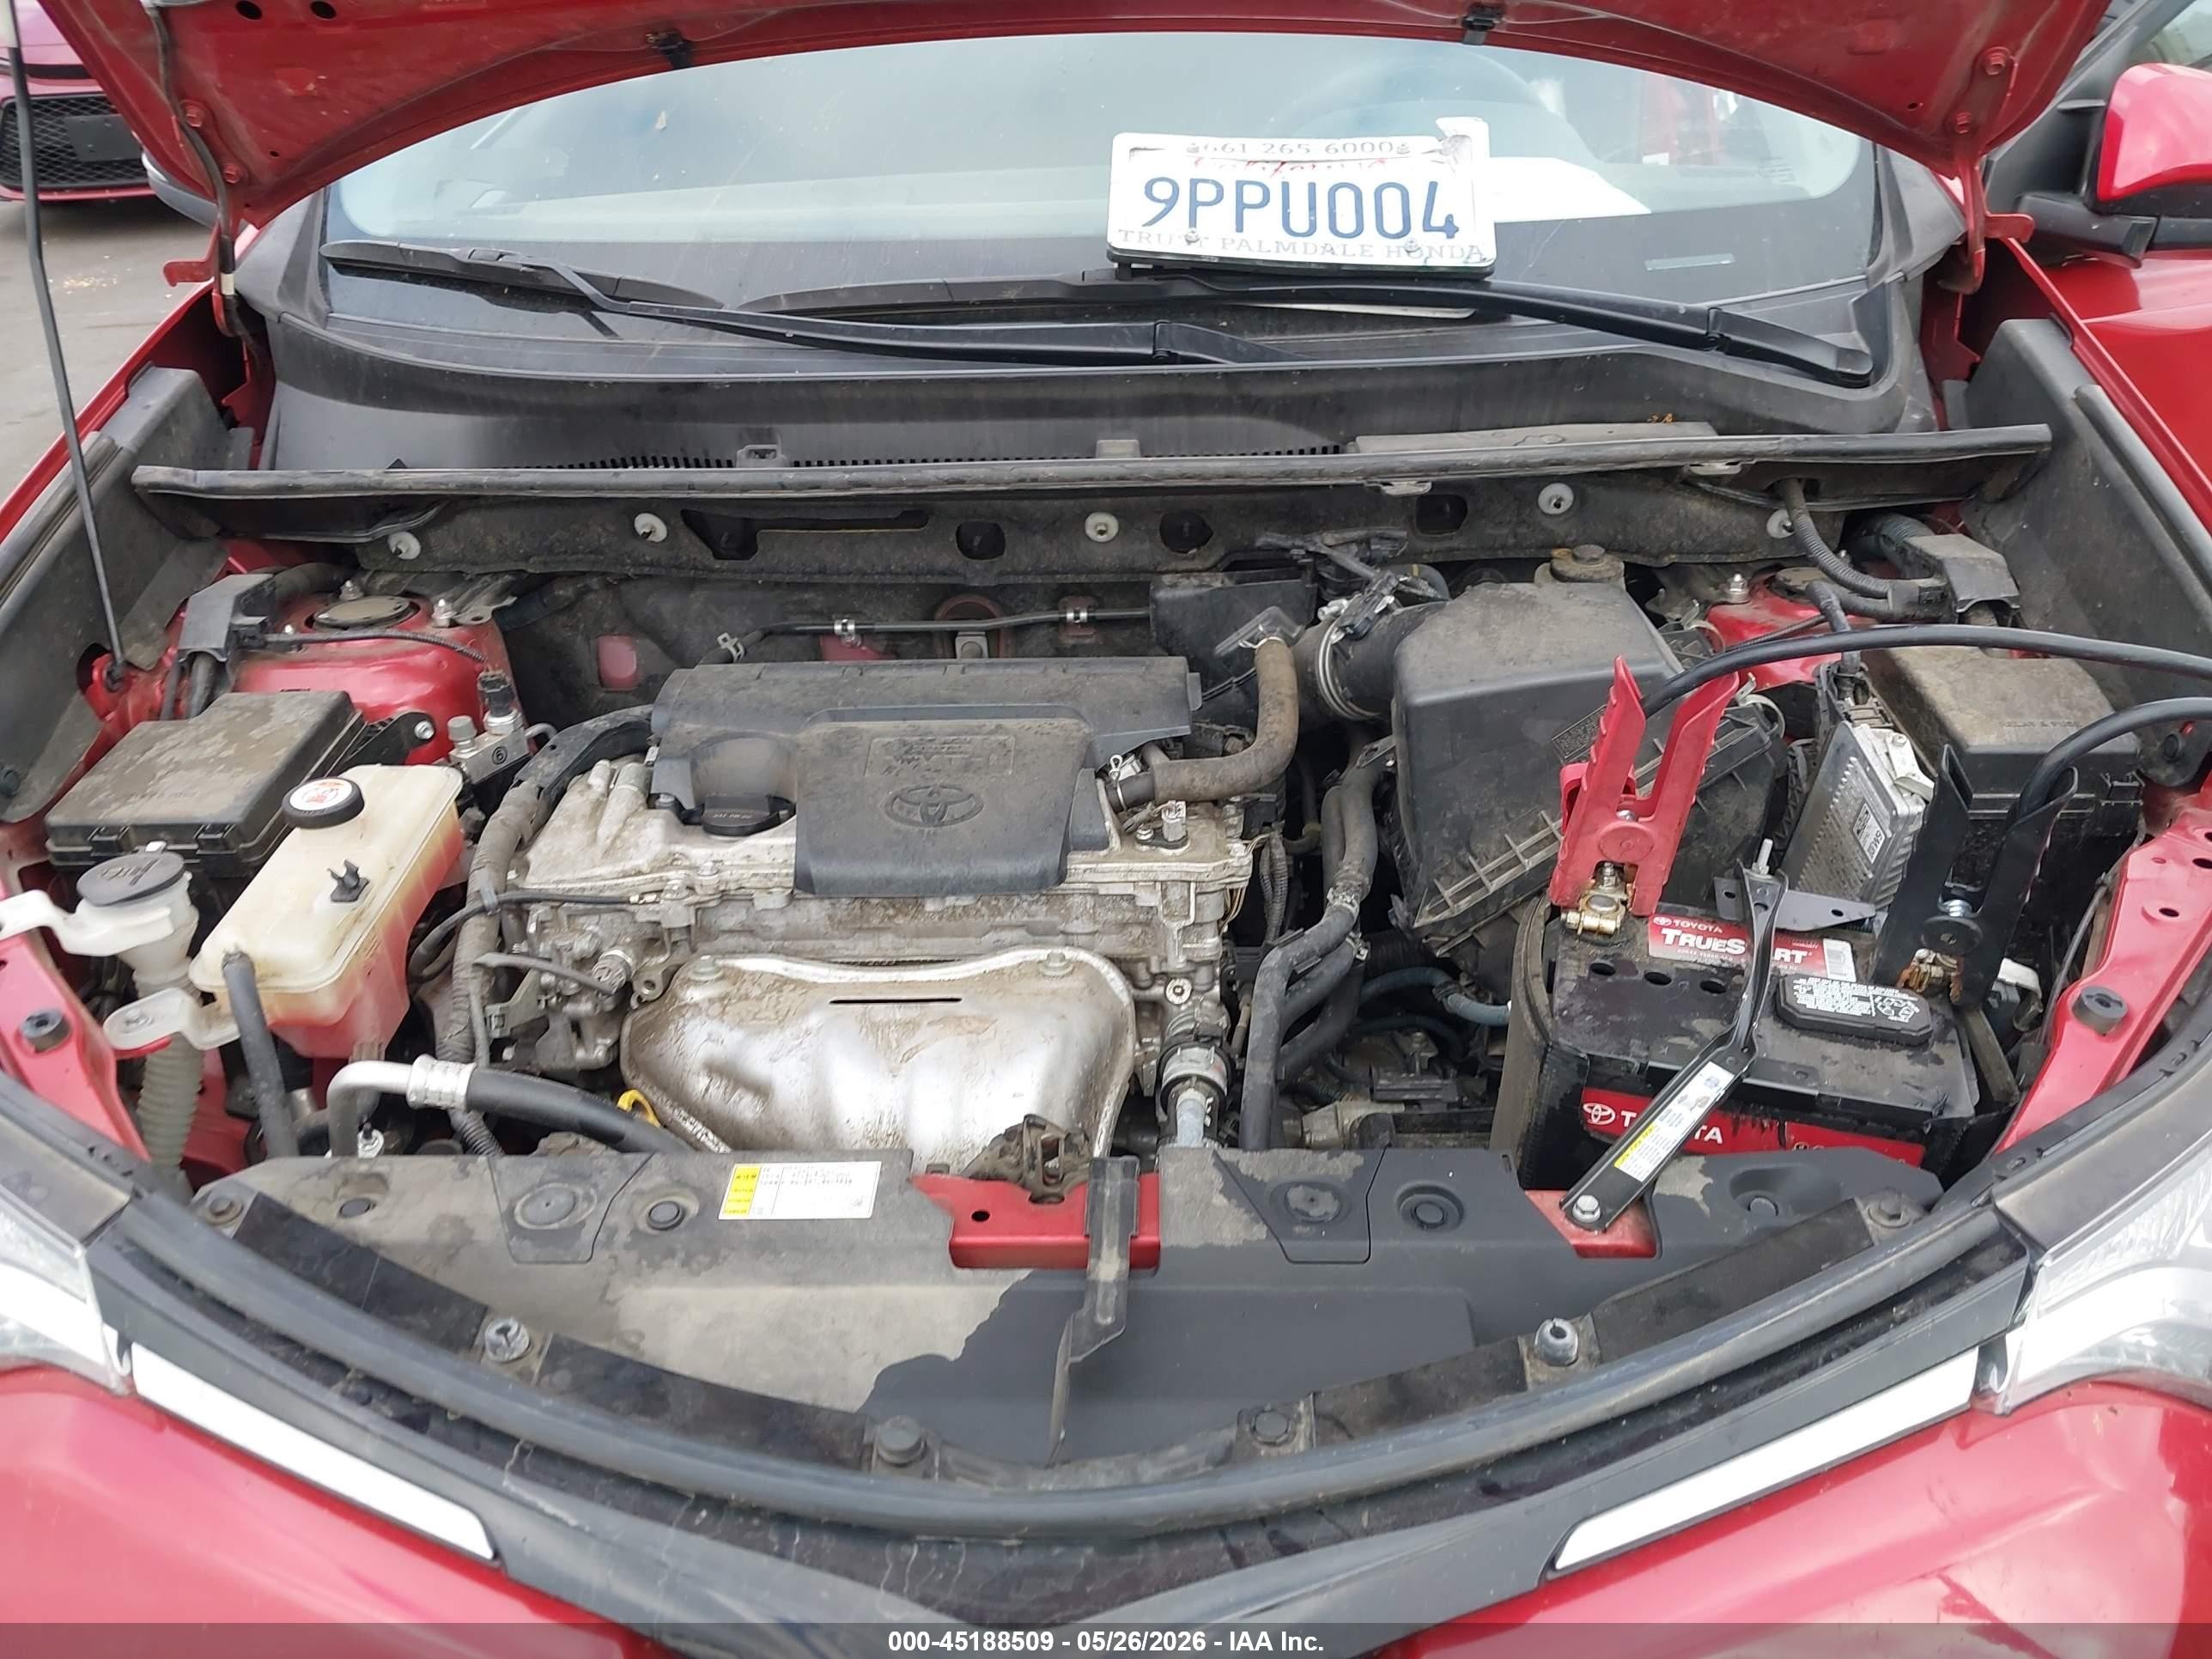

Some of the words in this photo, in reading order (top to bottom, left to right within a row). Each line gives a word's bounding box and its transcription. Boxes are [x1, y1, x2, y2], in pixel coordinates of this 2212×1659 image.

[1324, 141, 1395, 155] 6000
[1141, 177, 1459, 239] 9PPU004
[1220, 236, 1374, 258] PALMDALE
[1673, 920, 1723, 933] TOYOTA
[1661, 927, 1808, 964] TRUESRT
[1621, 1110, 1723, 1145] TTA
